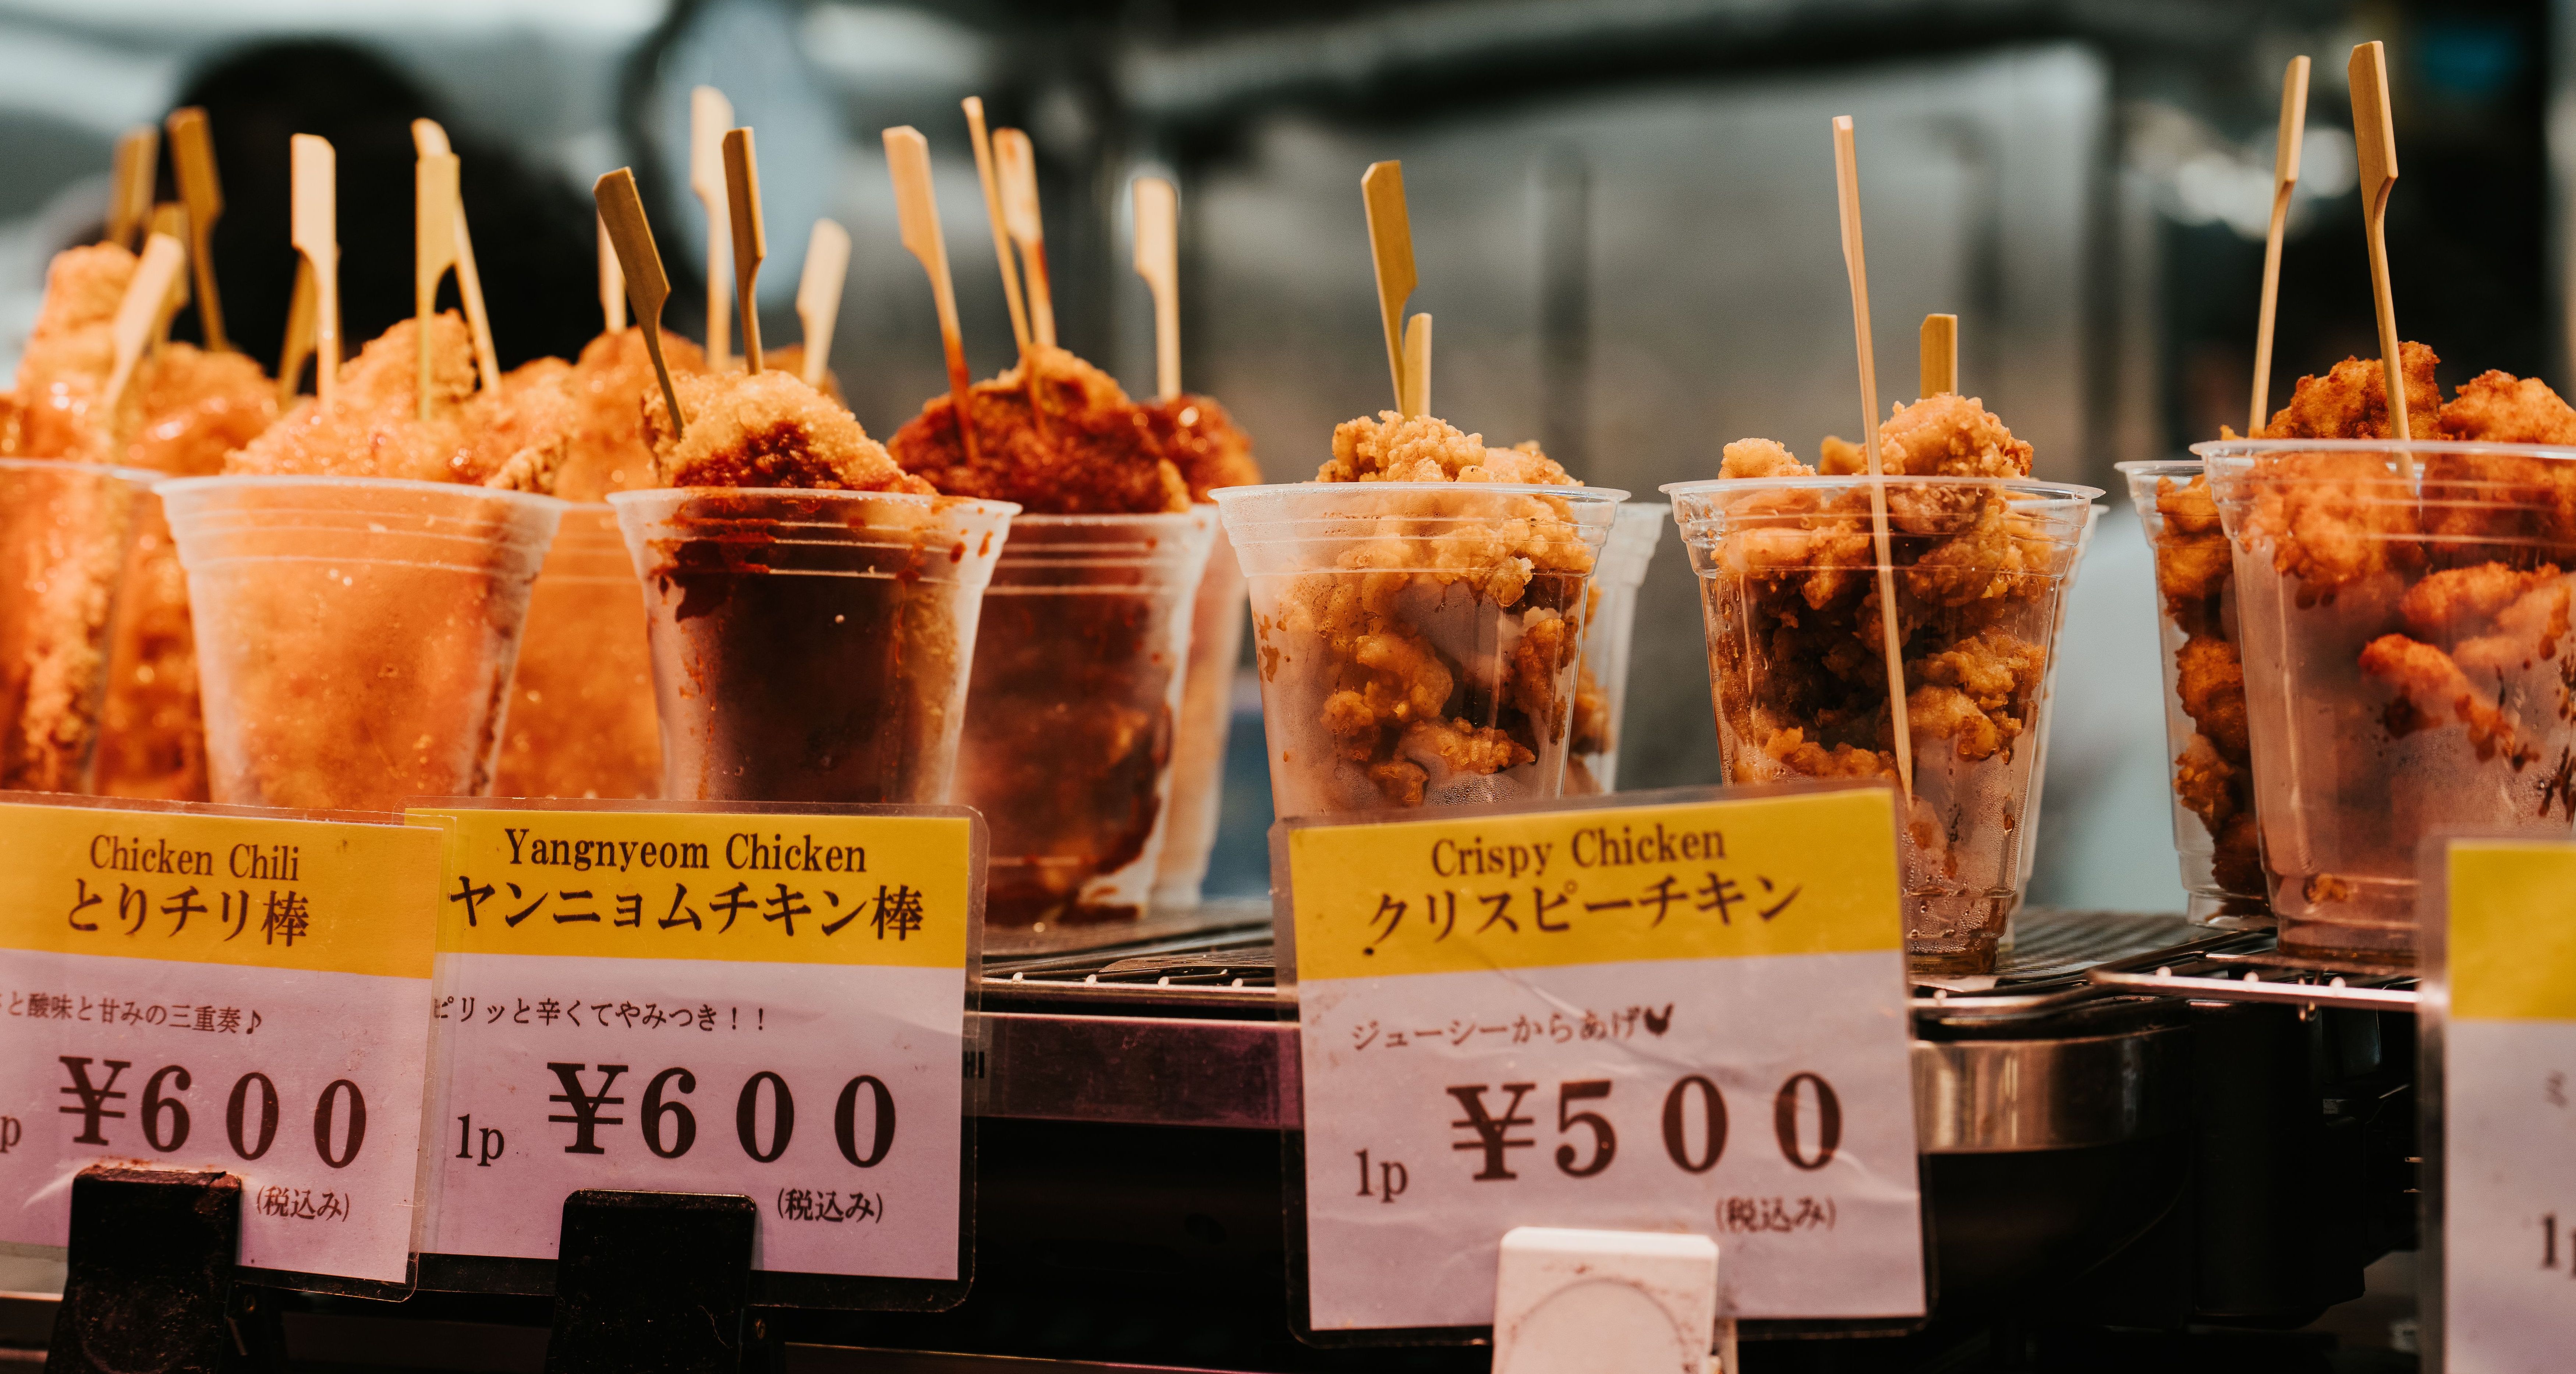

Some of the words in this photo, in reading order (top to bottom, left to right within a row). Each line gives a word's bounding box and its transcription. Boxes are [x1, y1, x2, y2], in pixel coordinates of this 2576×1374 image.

[90, 835, 213, 876] Chicken
[229, 844, 299, 880] Chili
[505, 829, 709, 872] Yangnyeom
[726, 833, 866, 872] Chicken
[1431, 836, 1553, 879] Crispy
[1570, 823, 1726, 868] Chicken
[69, 878, 309, 947] とりチリ棒
[449, 876, 923, 941] ヤンニョムチキン棒
[1369, 872, 1803, 942] クリスピーチキン
[0, 992, 239, 1034] と酸味と甘みの三重奏
[433, 996, 763, 1032] ピリッと辛くてやみつき！！
[1353, 1005, 1640, 1050] ジューシーからあげ
[456, 1114, 504, 1167] 1p
[1356, 1149, 1408, 1203] 1p
[256, 1187, 349, 1222] (税込み)
[777, 1188, 883, 1223] (税込み)
[1716, 1197, 1836, 1233] (税込み)
